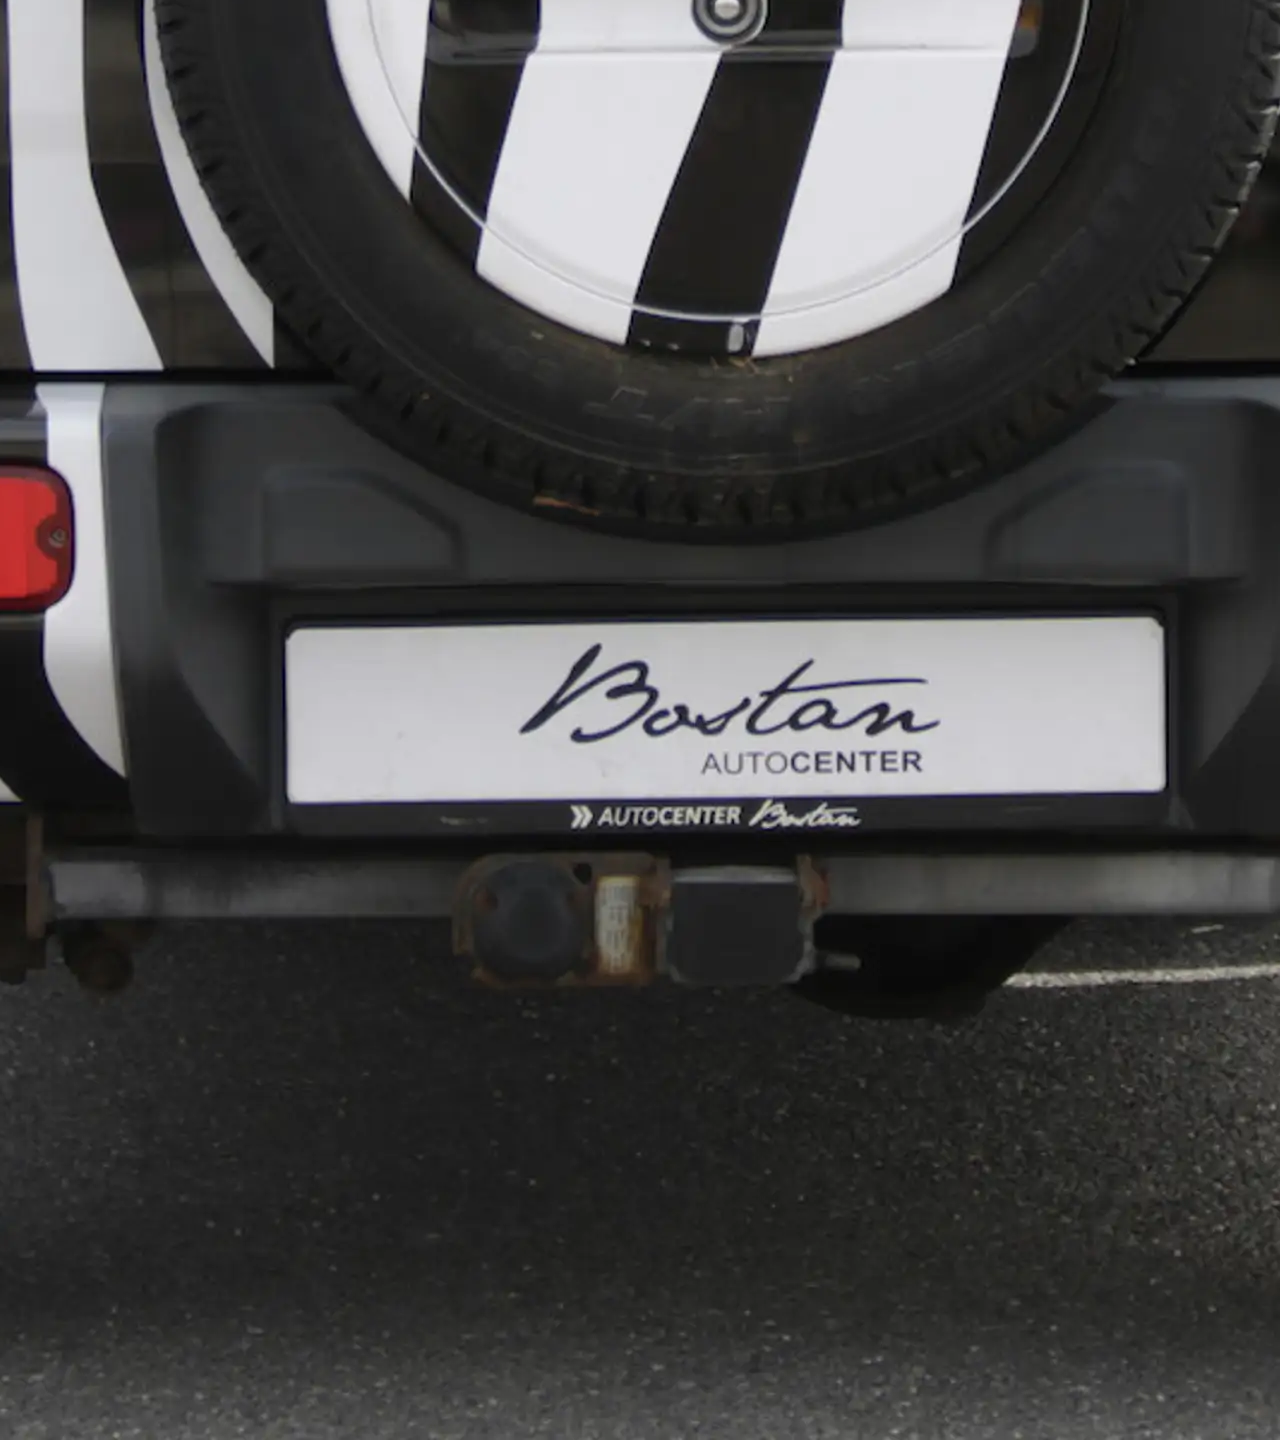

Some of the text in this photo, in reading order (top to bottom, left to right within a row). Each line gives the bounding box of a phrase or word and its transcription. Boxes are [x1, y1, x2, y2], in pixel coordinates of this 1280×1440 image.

[520, 643, 941, 743] Bostan
[701, 750, 923, 775] AUTOCENTER
[597, 798, 861, 829] AUTOCENTER Bostan
